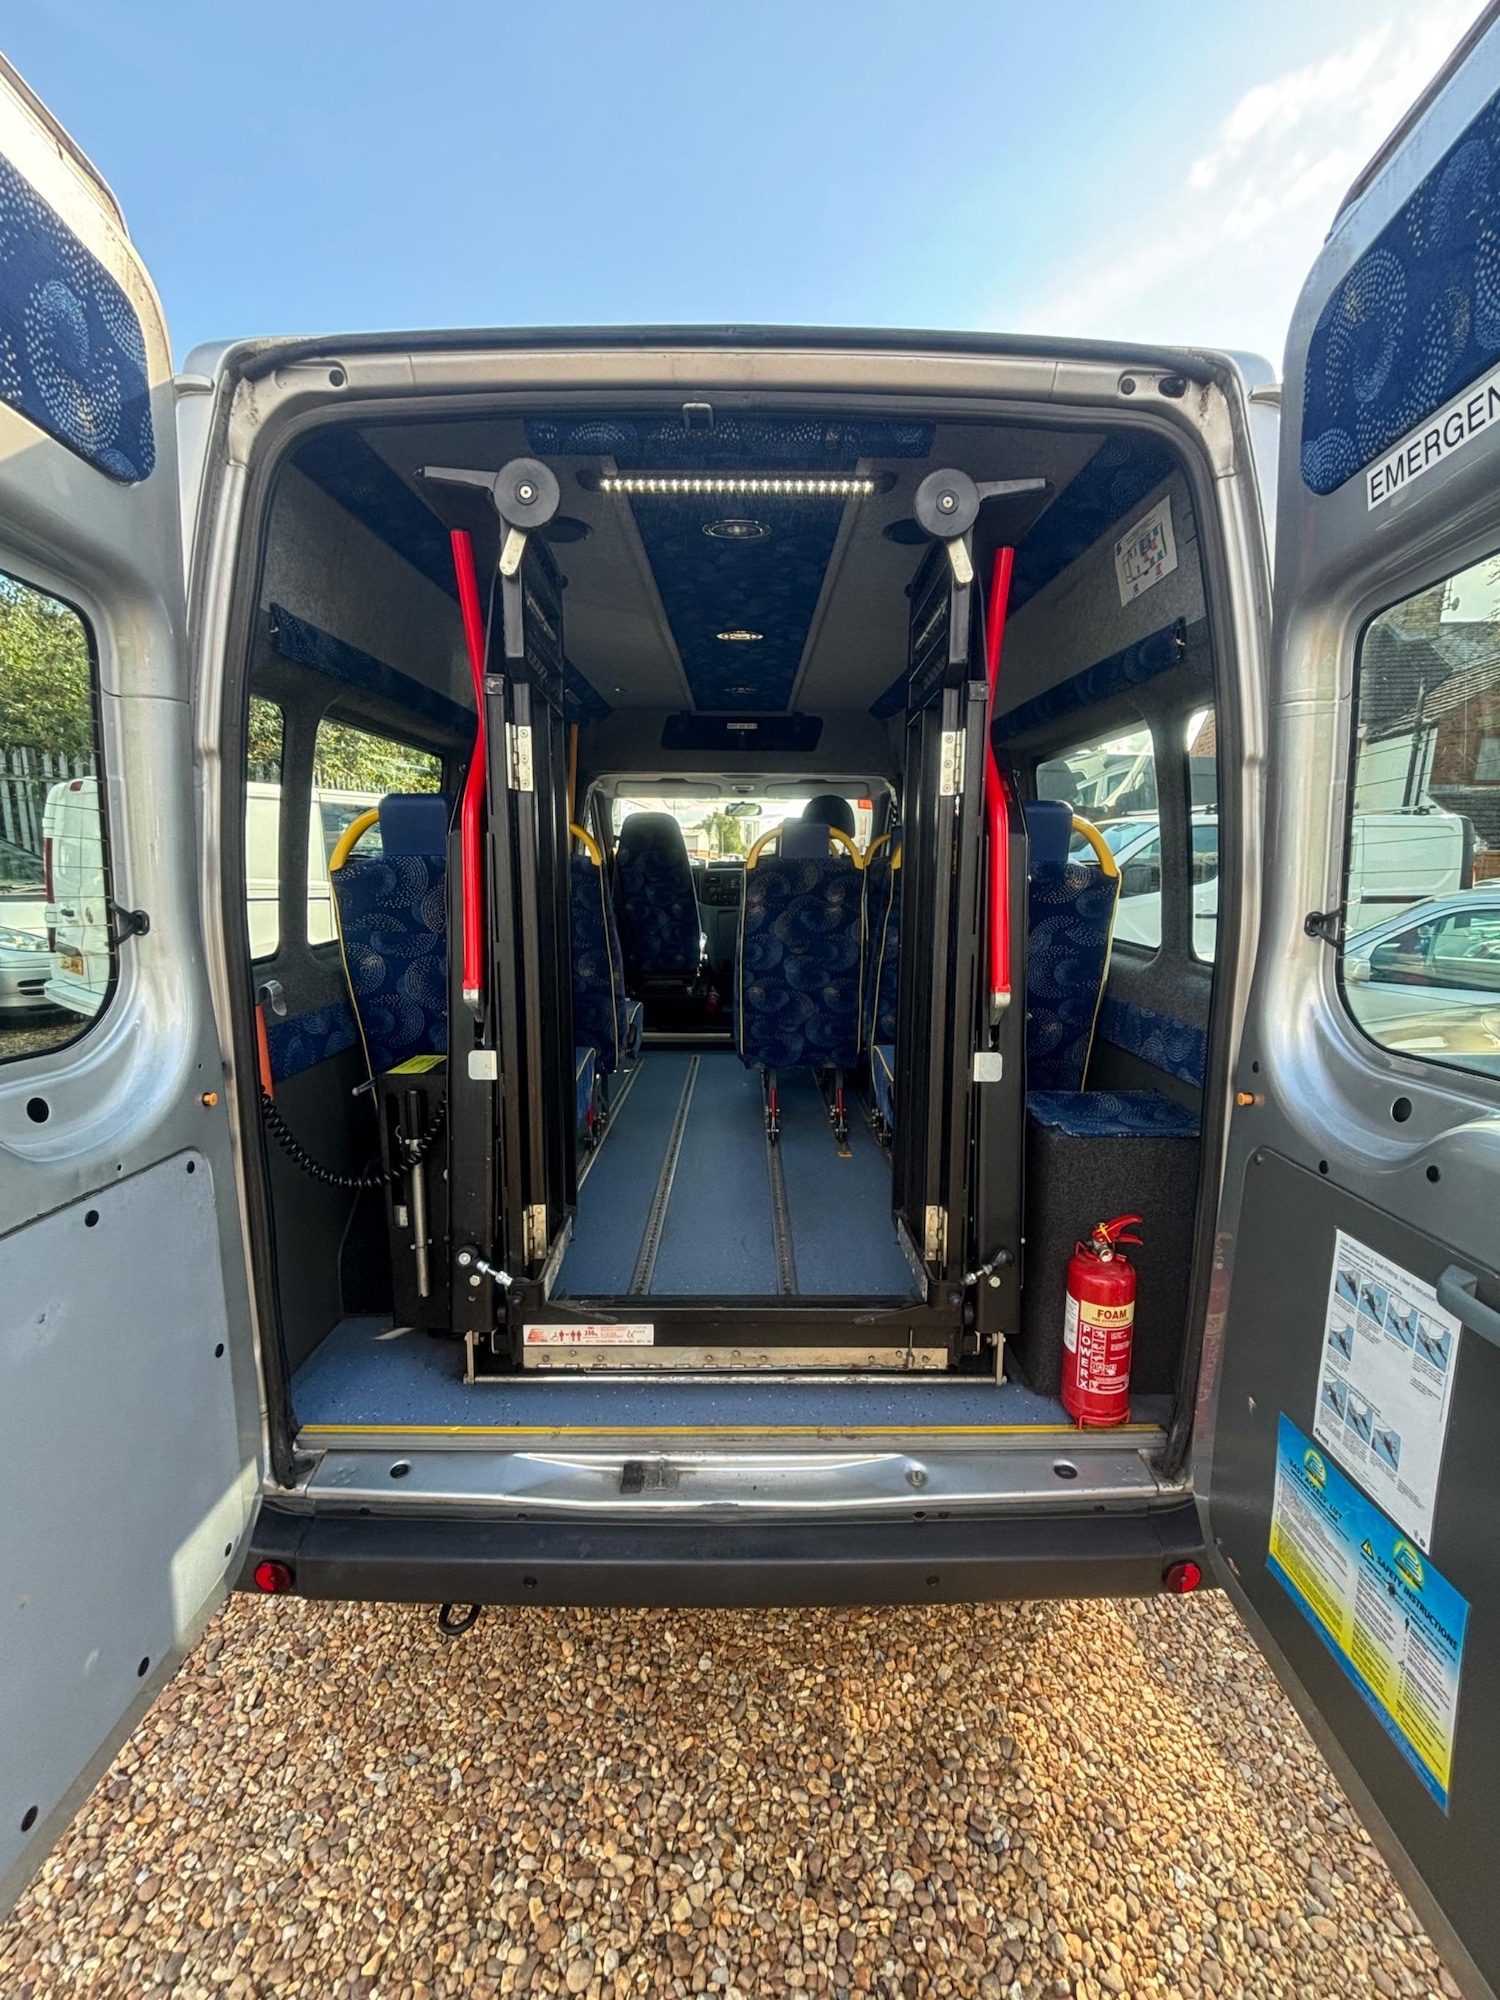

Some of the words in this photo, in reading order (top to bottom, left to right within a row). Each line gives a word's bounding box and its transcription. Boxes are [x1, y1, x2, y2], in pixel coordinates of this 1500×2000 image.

[1097, 1309, 1127, 1320] FOAM
[1376, 1555, 1403, 1587] SAFETY
[1403, 1584, 1458, 1651] INSTRUCTIONS
